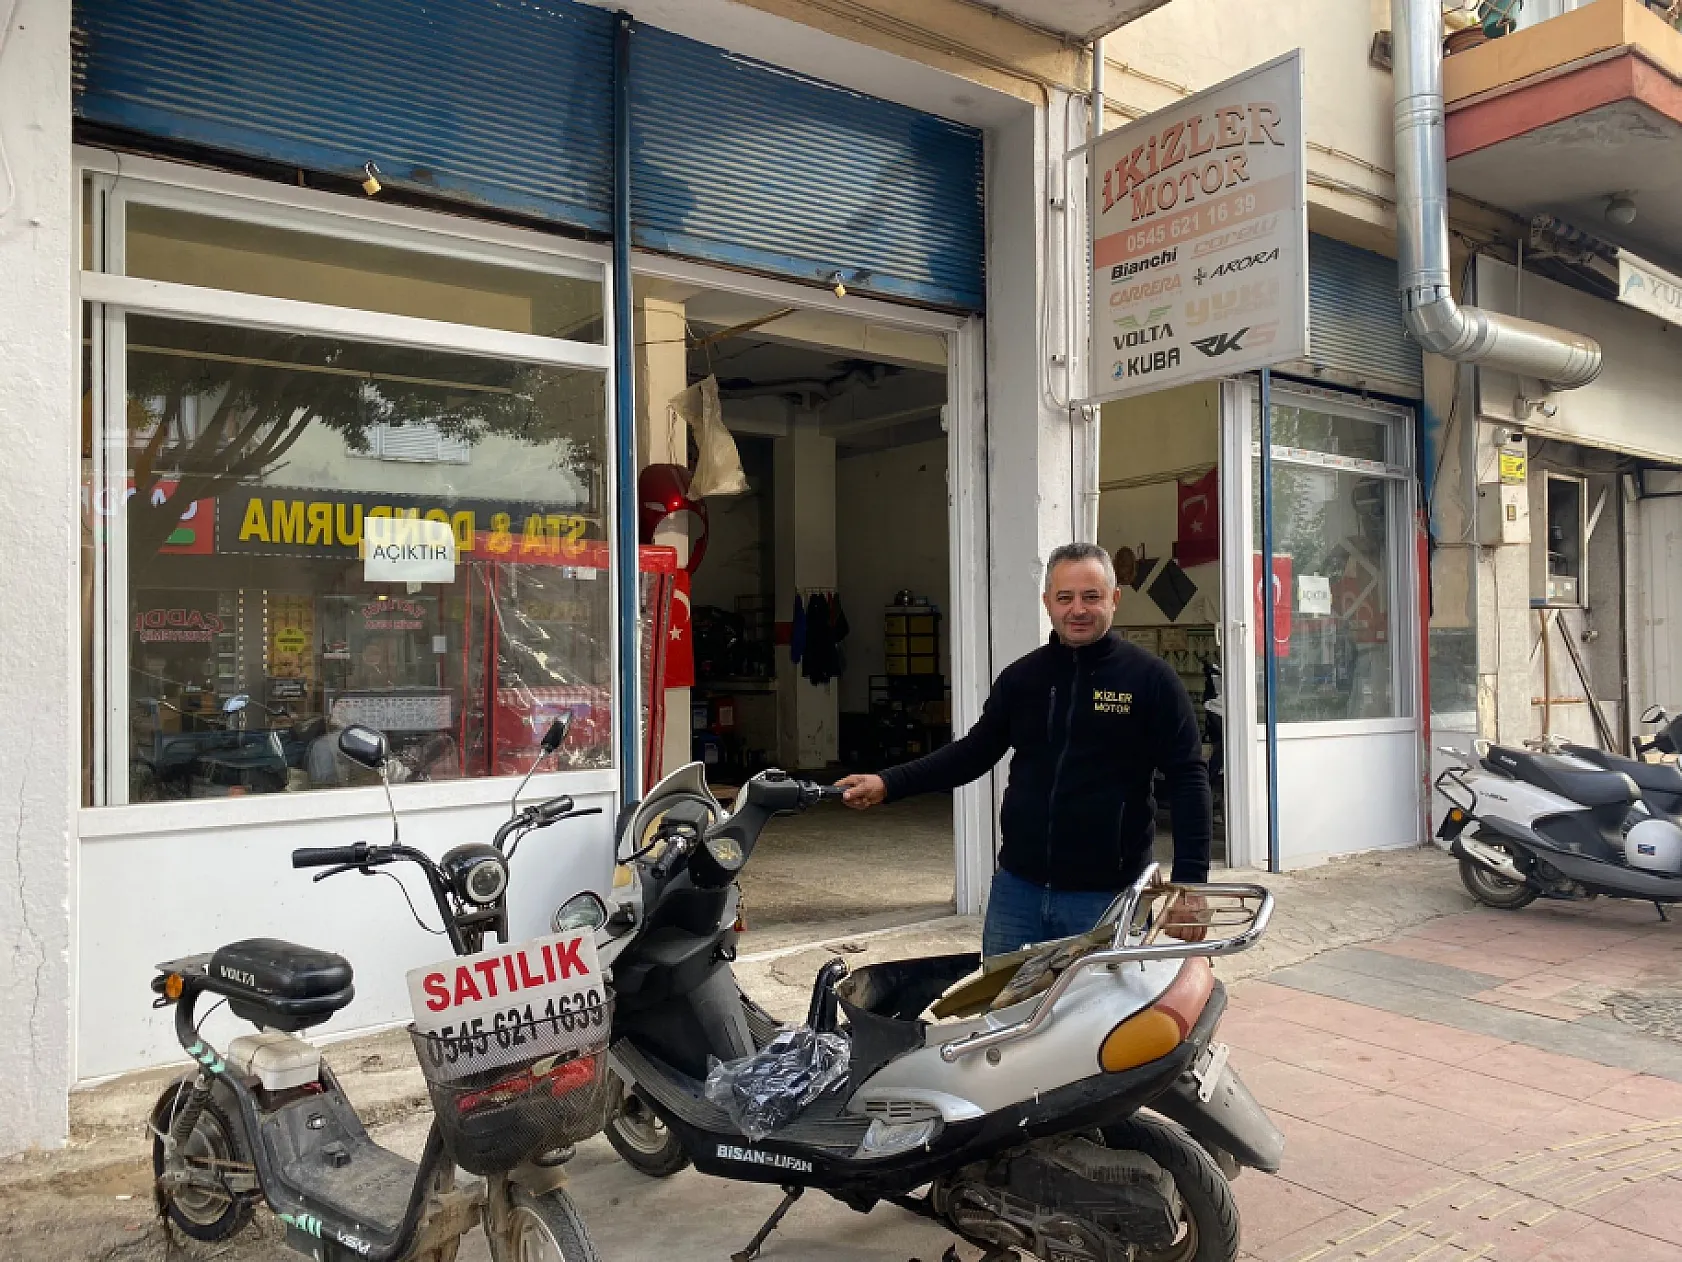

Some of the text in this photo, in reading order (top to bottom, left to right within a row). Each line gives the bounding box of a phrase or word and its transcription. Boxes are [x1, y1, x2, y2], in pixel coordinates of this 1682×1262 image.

[1130, 151, 1250, 221] MOTOR
[1127, 195, 1257, 253] 0545 621 16 39
[1110, 247, 1179, 280] Bianchi
[1209, 247, 1280, 279] ARORA
[1109, 274, 1183, 306] CARRERA
[1112, 323, 1175, 351] VOLTA
[1127, 348, 1181, 377] KUBA
[373, 544, 448, 563] AÇIKTIR
[1094, 702, 1131, 714] MOTOR
[220, 965, 255, 987] VOLTA
[423, 937, 590, 1012] SATILIK
[428, 989, 605, 1068] 0545 621 1639
